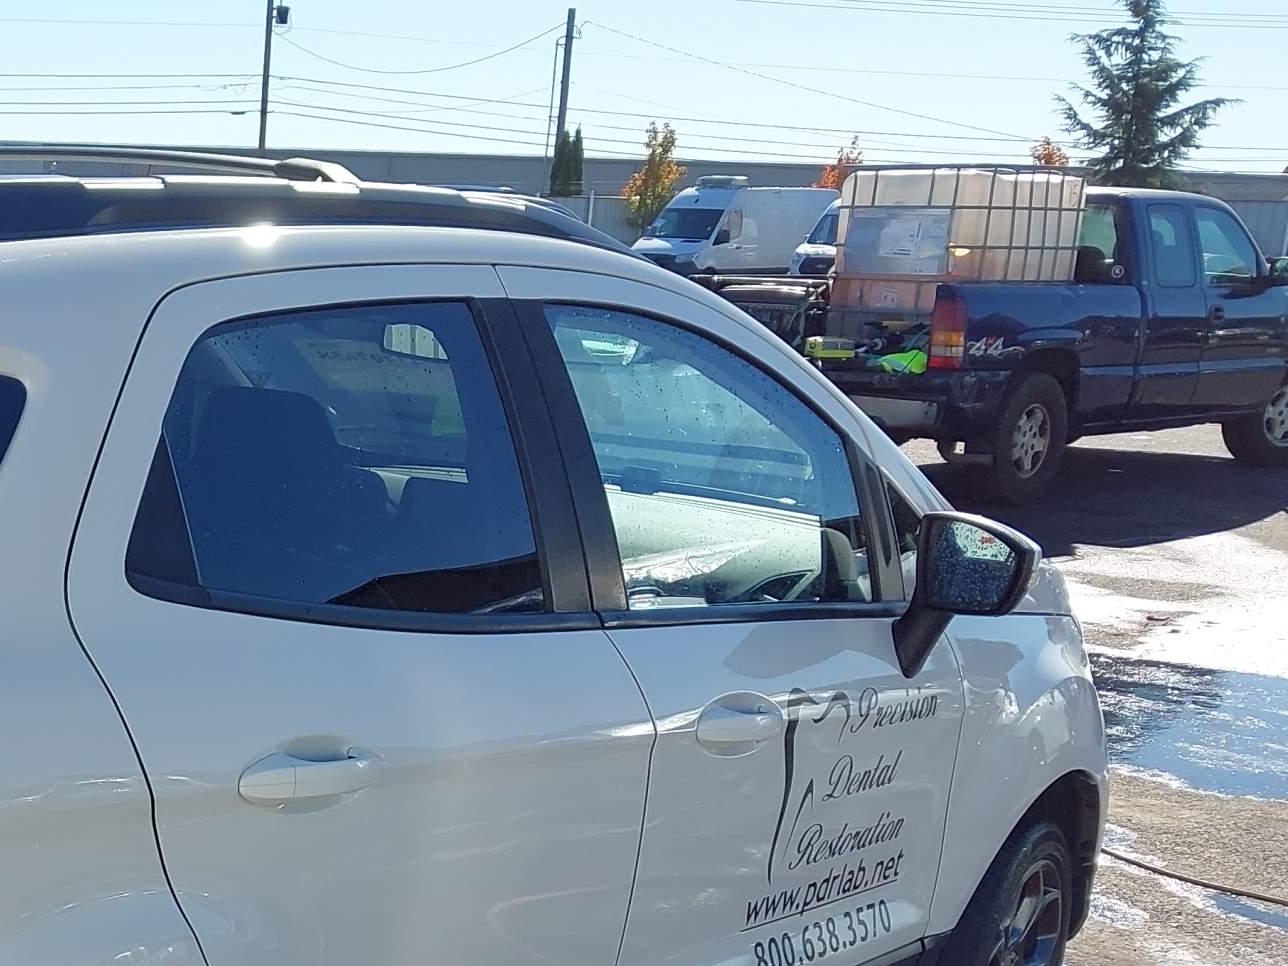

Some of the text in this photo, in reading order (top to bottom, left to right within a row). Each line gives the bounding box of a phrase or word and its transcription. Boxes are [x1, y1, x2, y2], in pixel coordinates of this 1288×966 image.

[850, 686, 938, 734] Precision
[822, 750, 903, 802] Dental
[789, 811, 904, 870] Restoration
[745, 848, 904, 927] www.pdrlab.net
